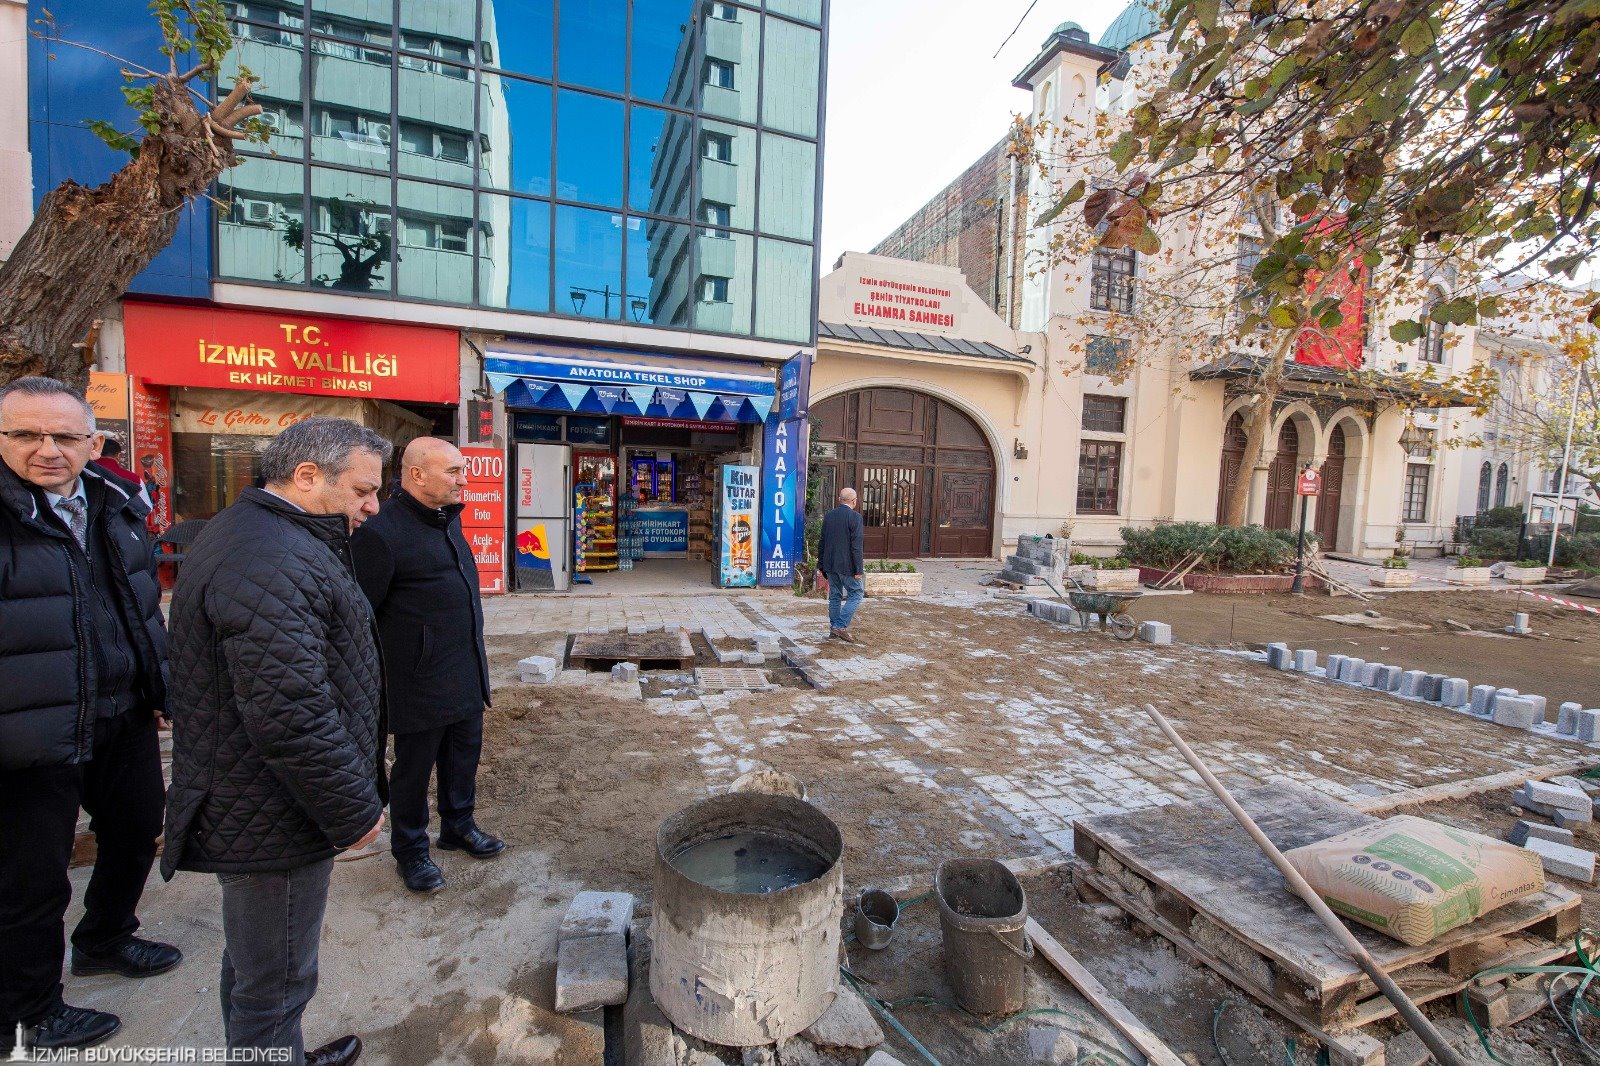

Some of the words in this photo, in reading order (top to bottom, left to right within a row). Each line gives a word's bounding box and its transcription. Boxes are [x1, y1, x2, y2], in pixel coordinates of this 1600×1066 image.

[879, 280, 916, 292] BÜYÜKŞEHİR
[917, 286, 951, 297] BELEDİYESİ
[870, 292, 893, 302] ŞEHİR
[895, 295, 941, 309] TİYATROLARI
[854, 302, 906, 320] ELHAMRA
[909, 310, 954, 327] SAHNESİ
[279, 323, 330, 347] T.C.
[198, 339, 277, 369] İZMİR
[290, 350, 398, 377] VALİLİĞİ
[229, 371, 252, 385] EK
[256, 371, 316, 388] HİZMET
[321, 376, 372, 392] BİNASI
[569, 367, 631, 380] ANATOLIA
[634, 372, 672, 384] TEKEL
[674, 376, 706, 387] SHOP
[197, 407, 219, 426] La
[223, 409, 271, 428] Gettoo
[463, 456, 503, 477] FOTO
[463, 490, 502, 502] Biometrik
[726, 486, 756, 499] TUTAR
[772, 421, 788, 559] ANATOLIA
[474, 508, 491, 521] Foto
[472, 533, 493, 546] Acele
[651, 528, 686, 536] FOTOKOPİ
[765, 561, 790, 569] TEKEL
[765, 569, 789, 578] SHOP
